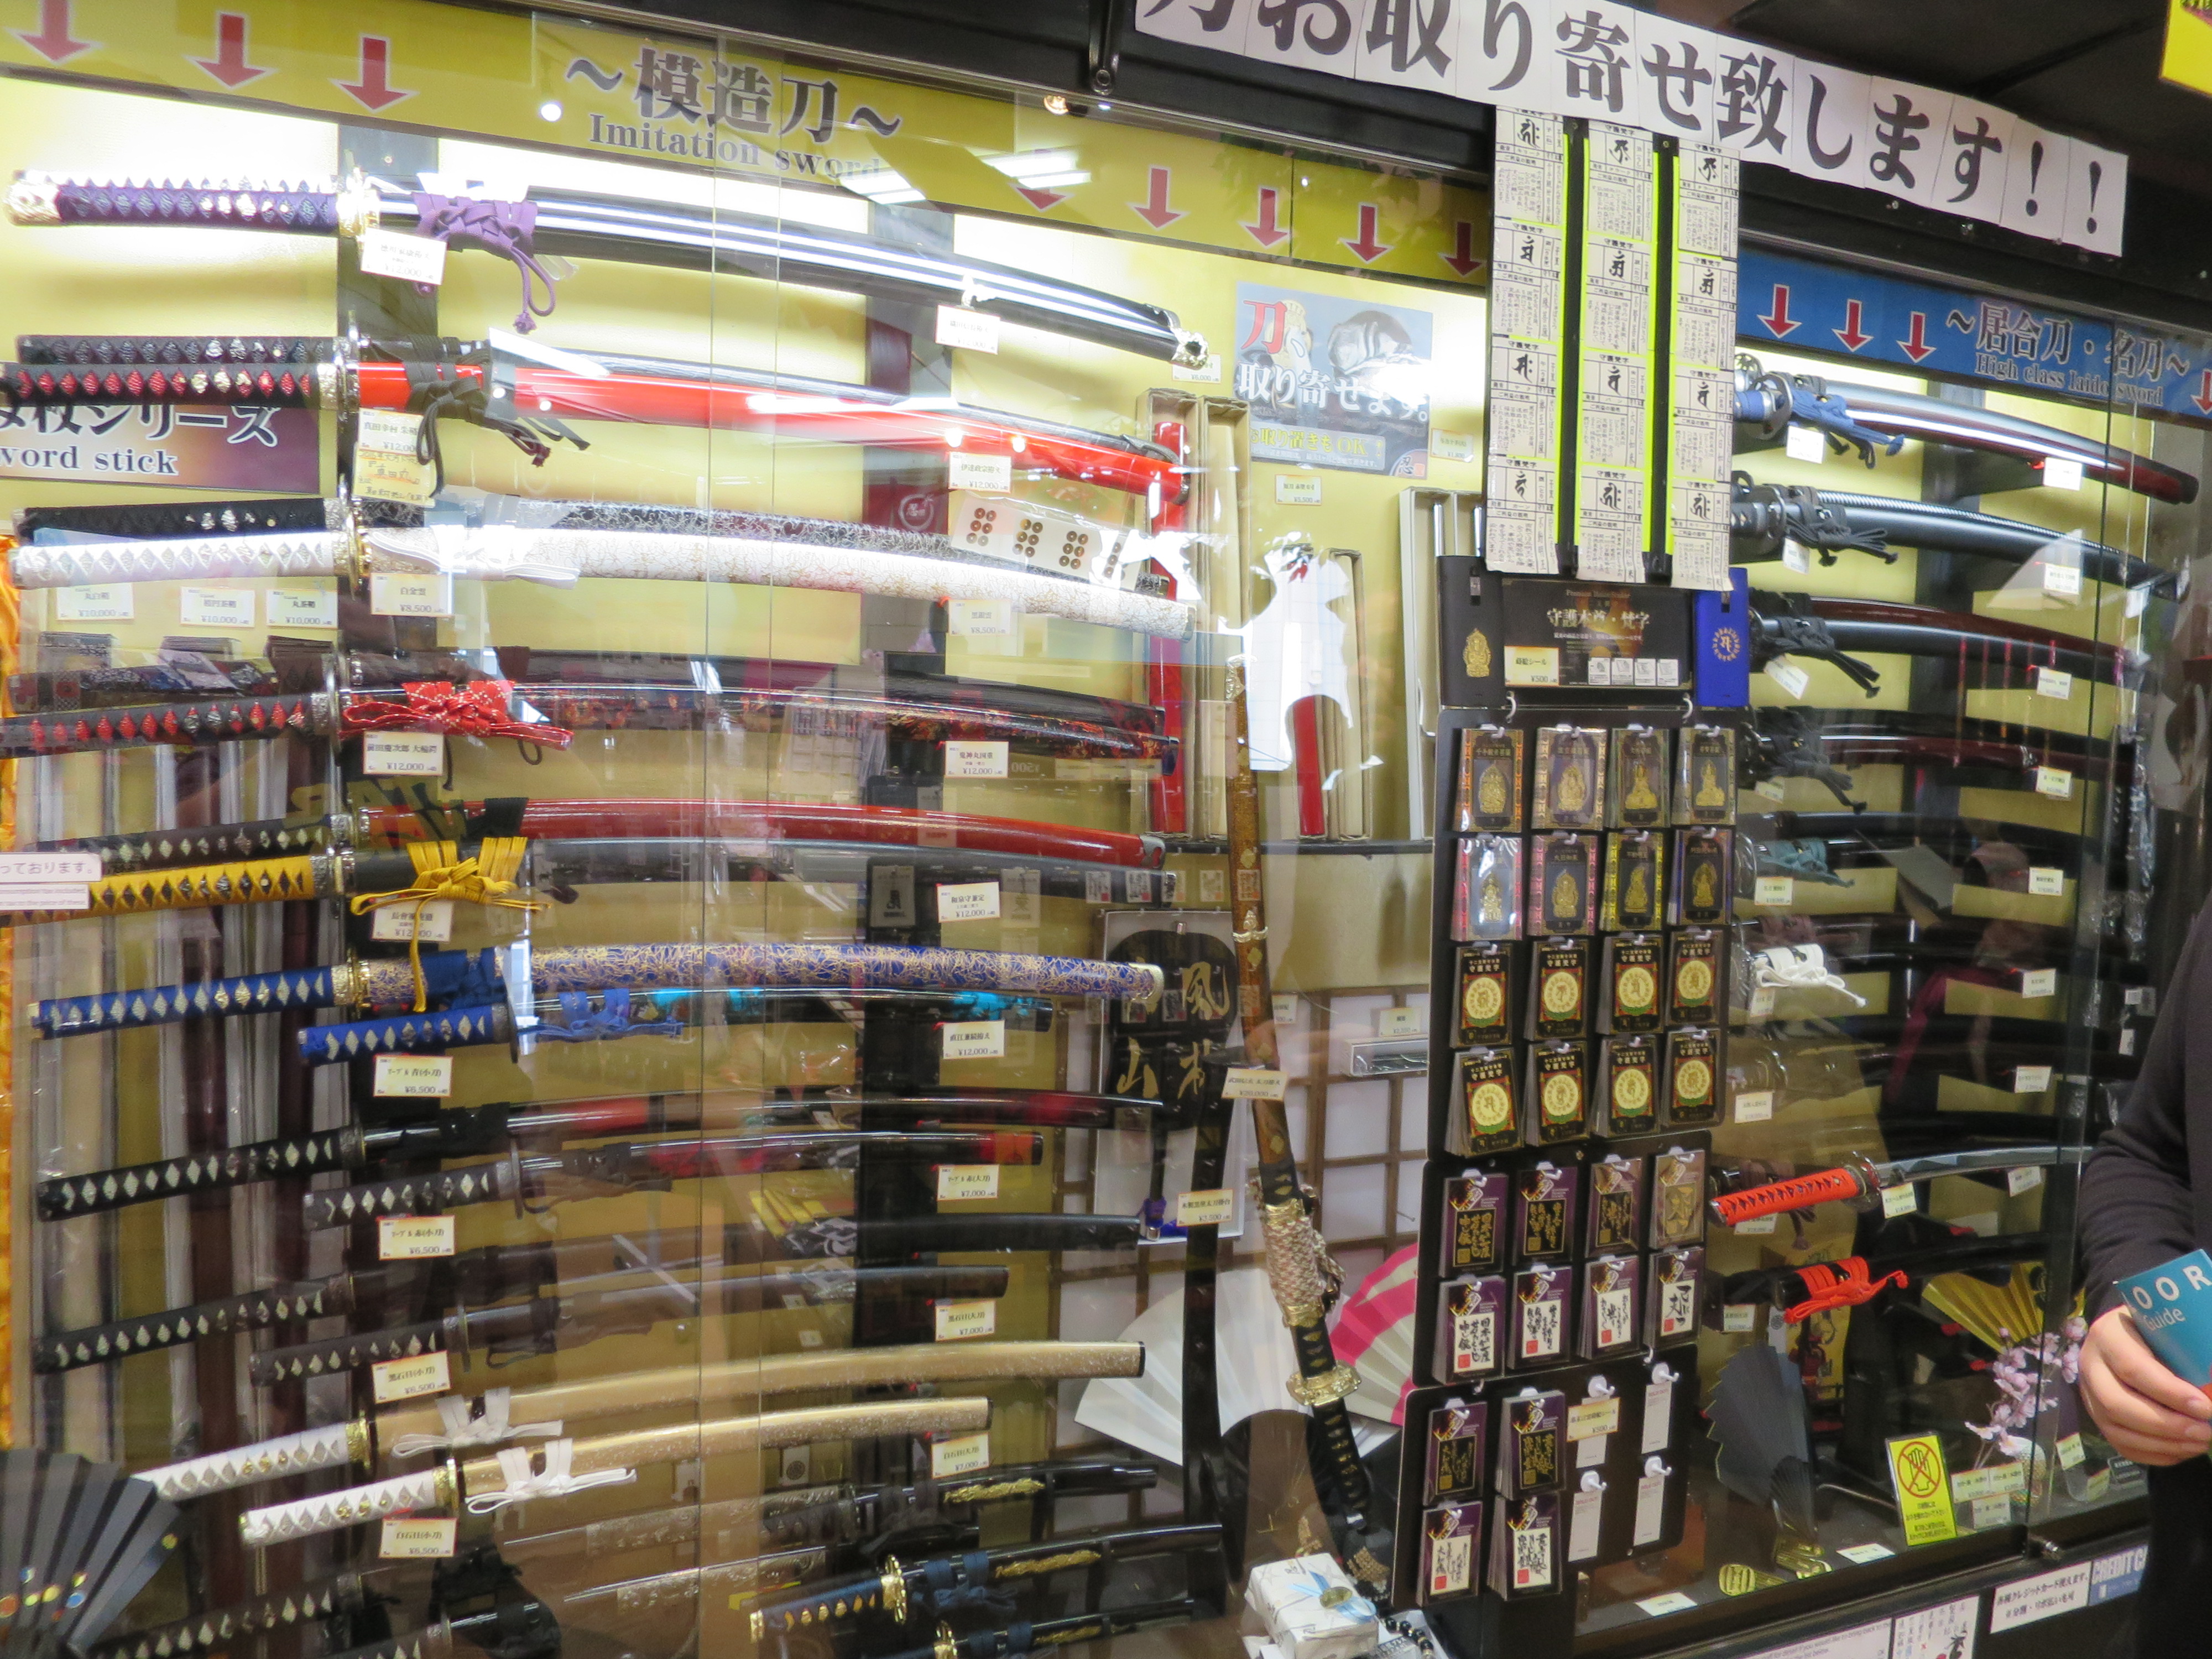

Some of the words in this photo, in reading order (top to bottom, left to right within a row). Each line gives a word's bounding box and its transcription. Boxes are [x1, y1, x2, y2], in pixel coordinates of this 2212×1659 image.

[590, 113, 759, 166] Imitation
[775, 150, 880, 181] sword
[1975, 352, 2018, 380] High
[2024, 363, 2065, 388] class
[95, 448, 178, 474] stick
[969, 480, 999, 490] ¥12,000
[400, 603, 431, 613] ¥8,500
[201, 615, 237, 624] ¥10,000
[286, 617, 320, 625] ¥10,000
[971, 626, 995, 635] ¥8,500
[387, 763, 424, 771] ¥12,000
[956, 910, 985, 918] ¥12,000
[958, 1048, 988, 1056] ¥12,000
[2143, 1307, 2185, 1331] Guide
[959, 1327, 983, 1335] ¥7,000
[405, 1384, 435, 1395] ¥6,500
[409, 1547, 439, 1555] ¥6,500
